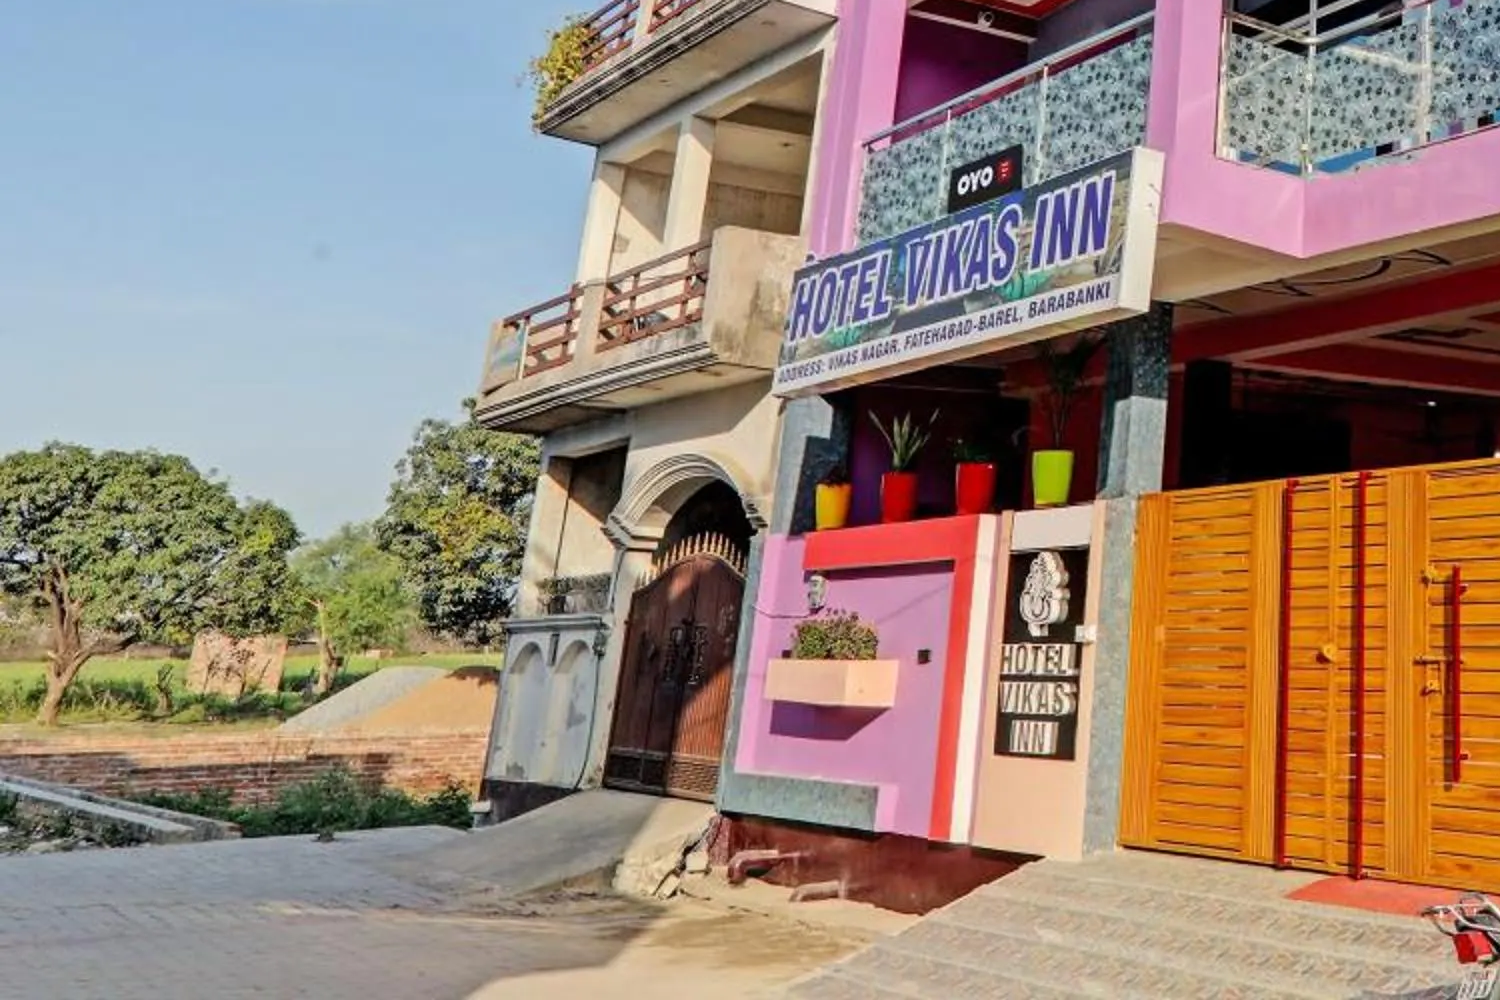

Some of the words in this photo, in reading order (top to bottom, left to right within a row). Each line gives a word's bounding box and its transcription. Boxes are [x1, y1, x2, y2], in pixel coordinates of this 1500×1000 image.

[957, 165, 994, 196] OYO
[789, 251, 893, 344] HOTEL
[902, 203, 1022, 307] VIKAS
[1030, 171, 1116, 270] INN
[777, 359, 825, 384] ADDRESS:
[828, 350, 859, 371] VIKAS
[1029, 281, 1110, 319] BARABANKI
[1000, 643, 1081, 677] HOTEL
[999, 680, 1078, 715] VIKAS
[1009, 719, 1060, 755] INN
